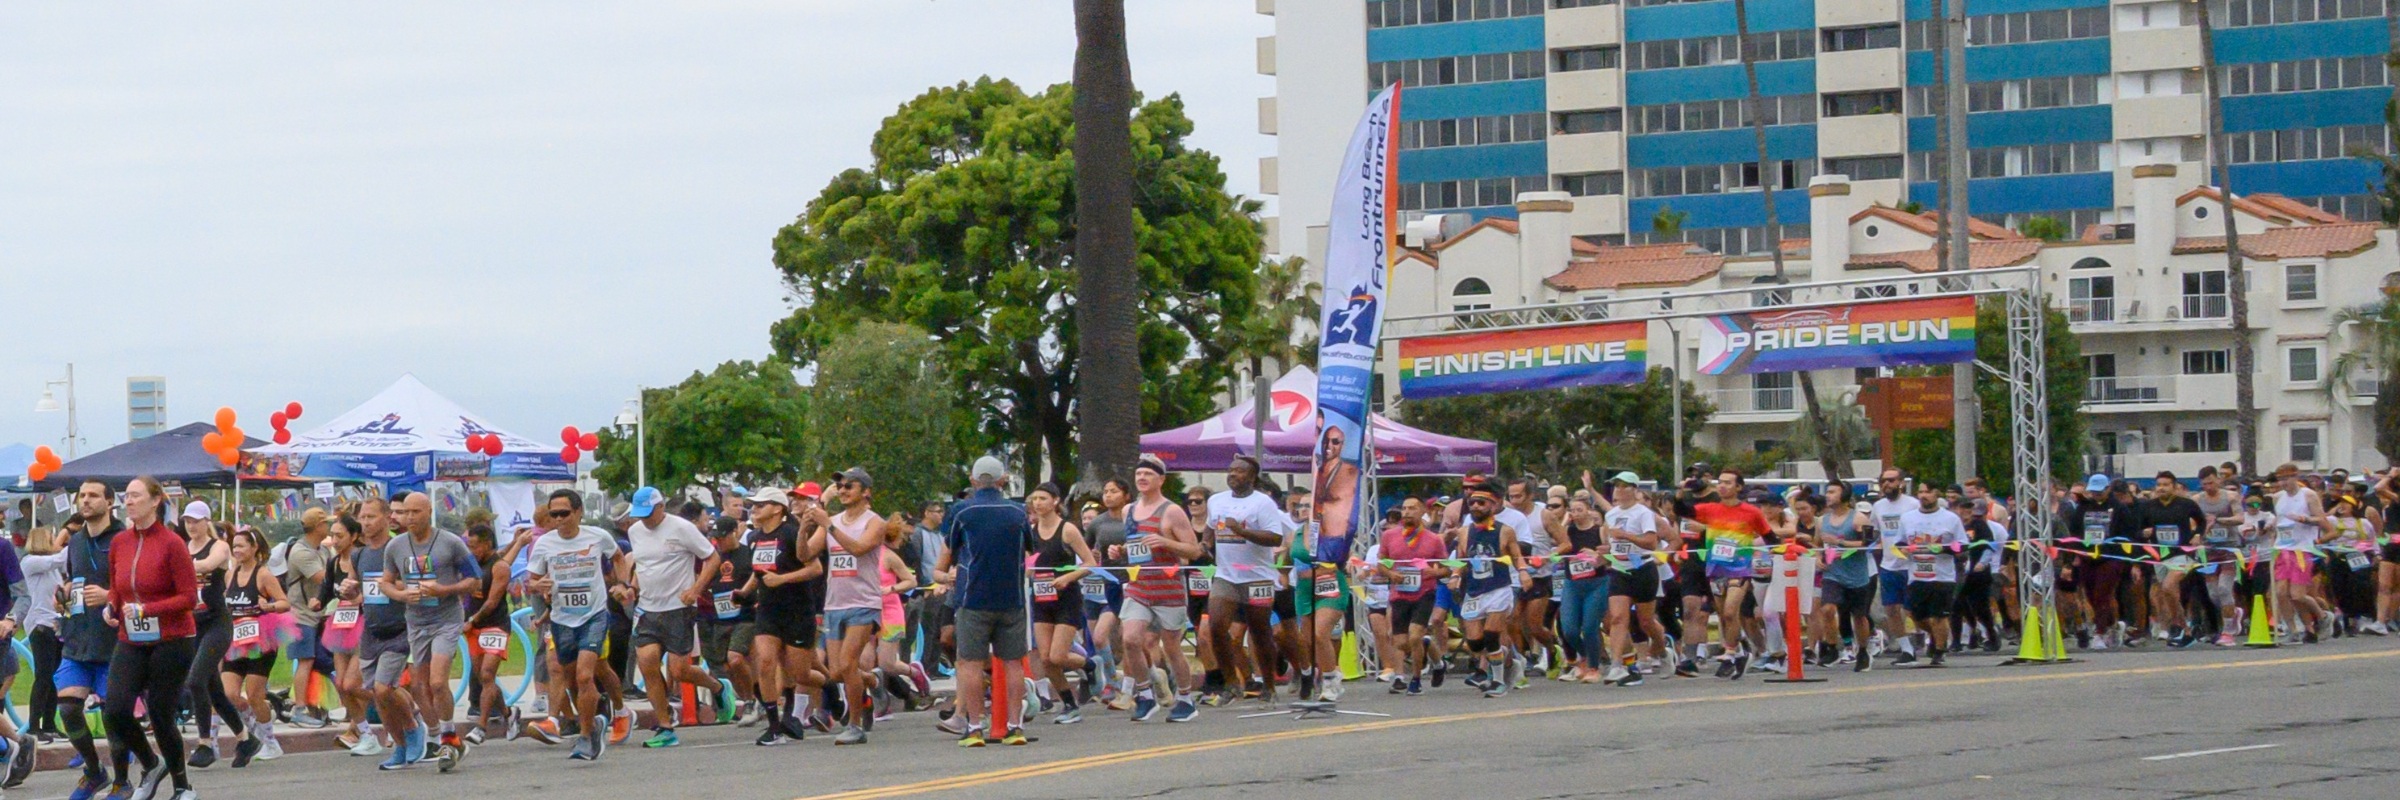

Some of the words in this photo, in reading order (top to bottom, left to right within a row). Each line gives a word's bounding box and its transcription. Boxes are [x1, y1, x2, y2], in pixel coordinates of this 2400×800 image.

[1362, 113, 1377, 180] Beach
[1372, 98, 1390, 290] Frontrunners
[1361, 186, 1372, 240] Long
[1752, 318, 1833, 330] Frontrunners
[1726, 324, 1849, 353] PRIDE
[1860, 317, 1949, 345] RUN
[1414, 348, 1532, 377] FINISH
[1542, 341, 1627, 367] LINE
[290, 440, 416, 449] Frontrunners
[1263, 453, 1312, 463] Registration
[1129, 544, 1147, 555] 270
[757, 551, 773, 562] 426
[834, 557, 853, 568] 424
[1086, 584, 1102, 594] 237
[564, 594, 588, 606] 188
[132, 618, 150, 632] 96
[236, 625, 255, 638] 383
[482, 637, 502, 647] 321
